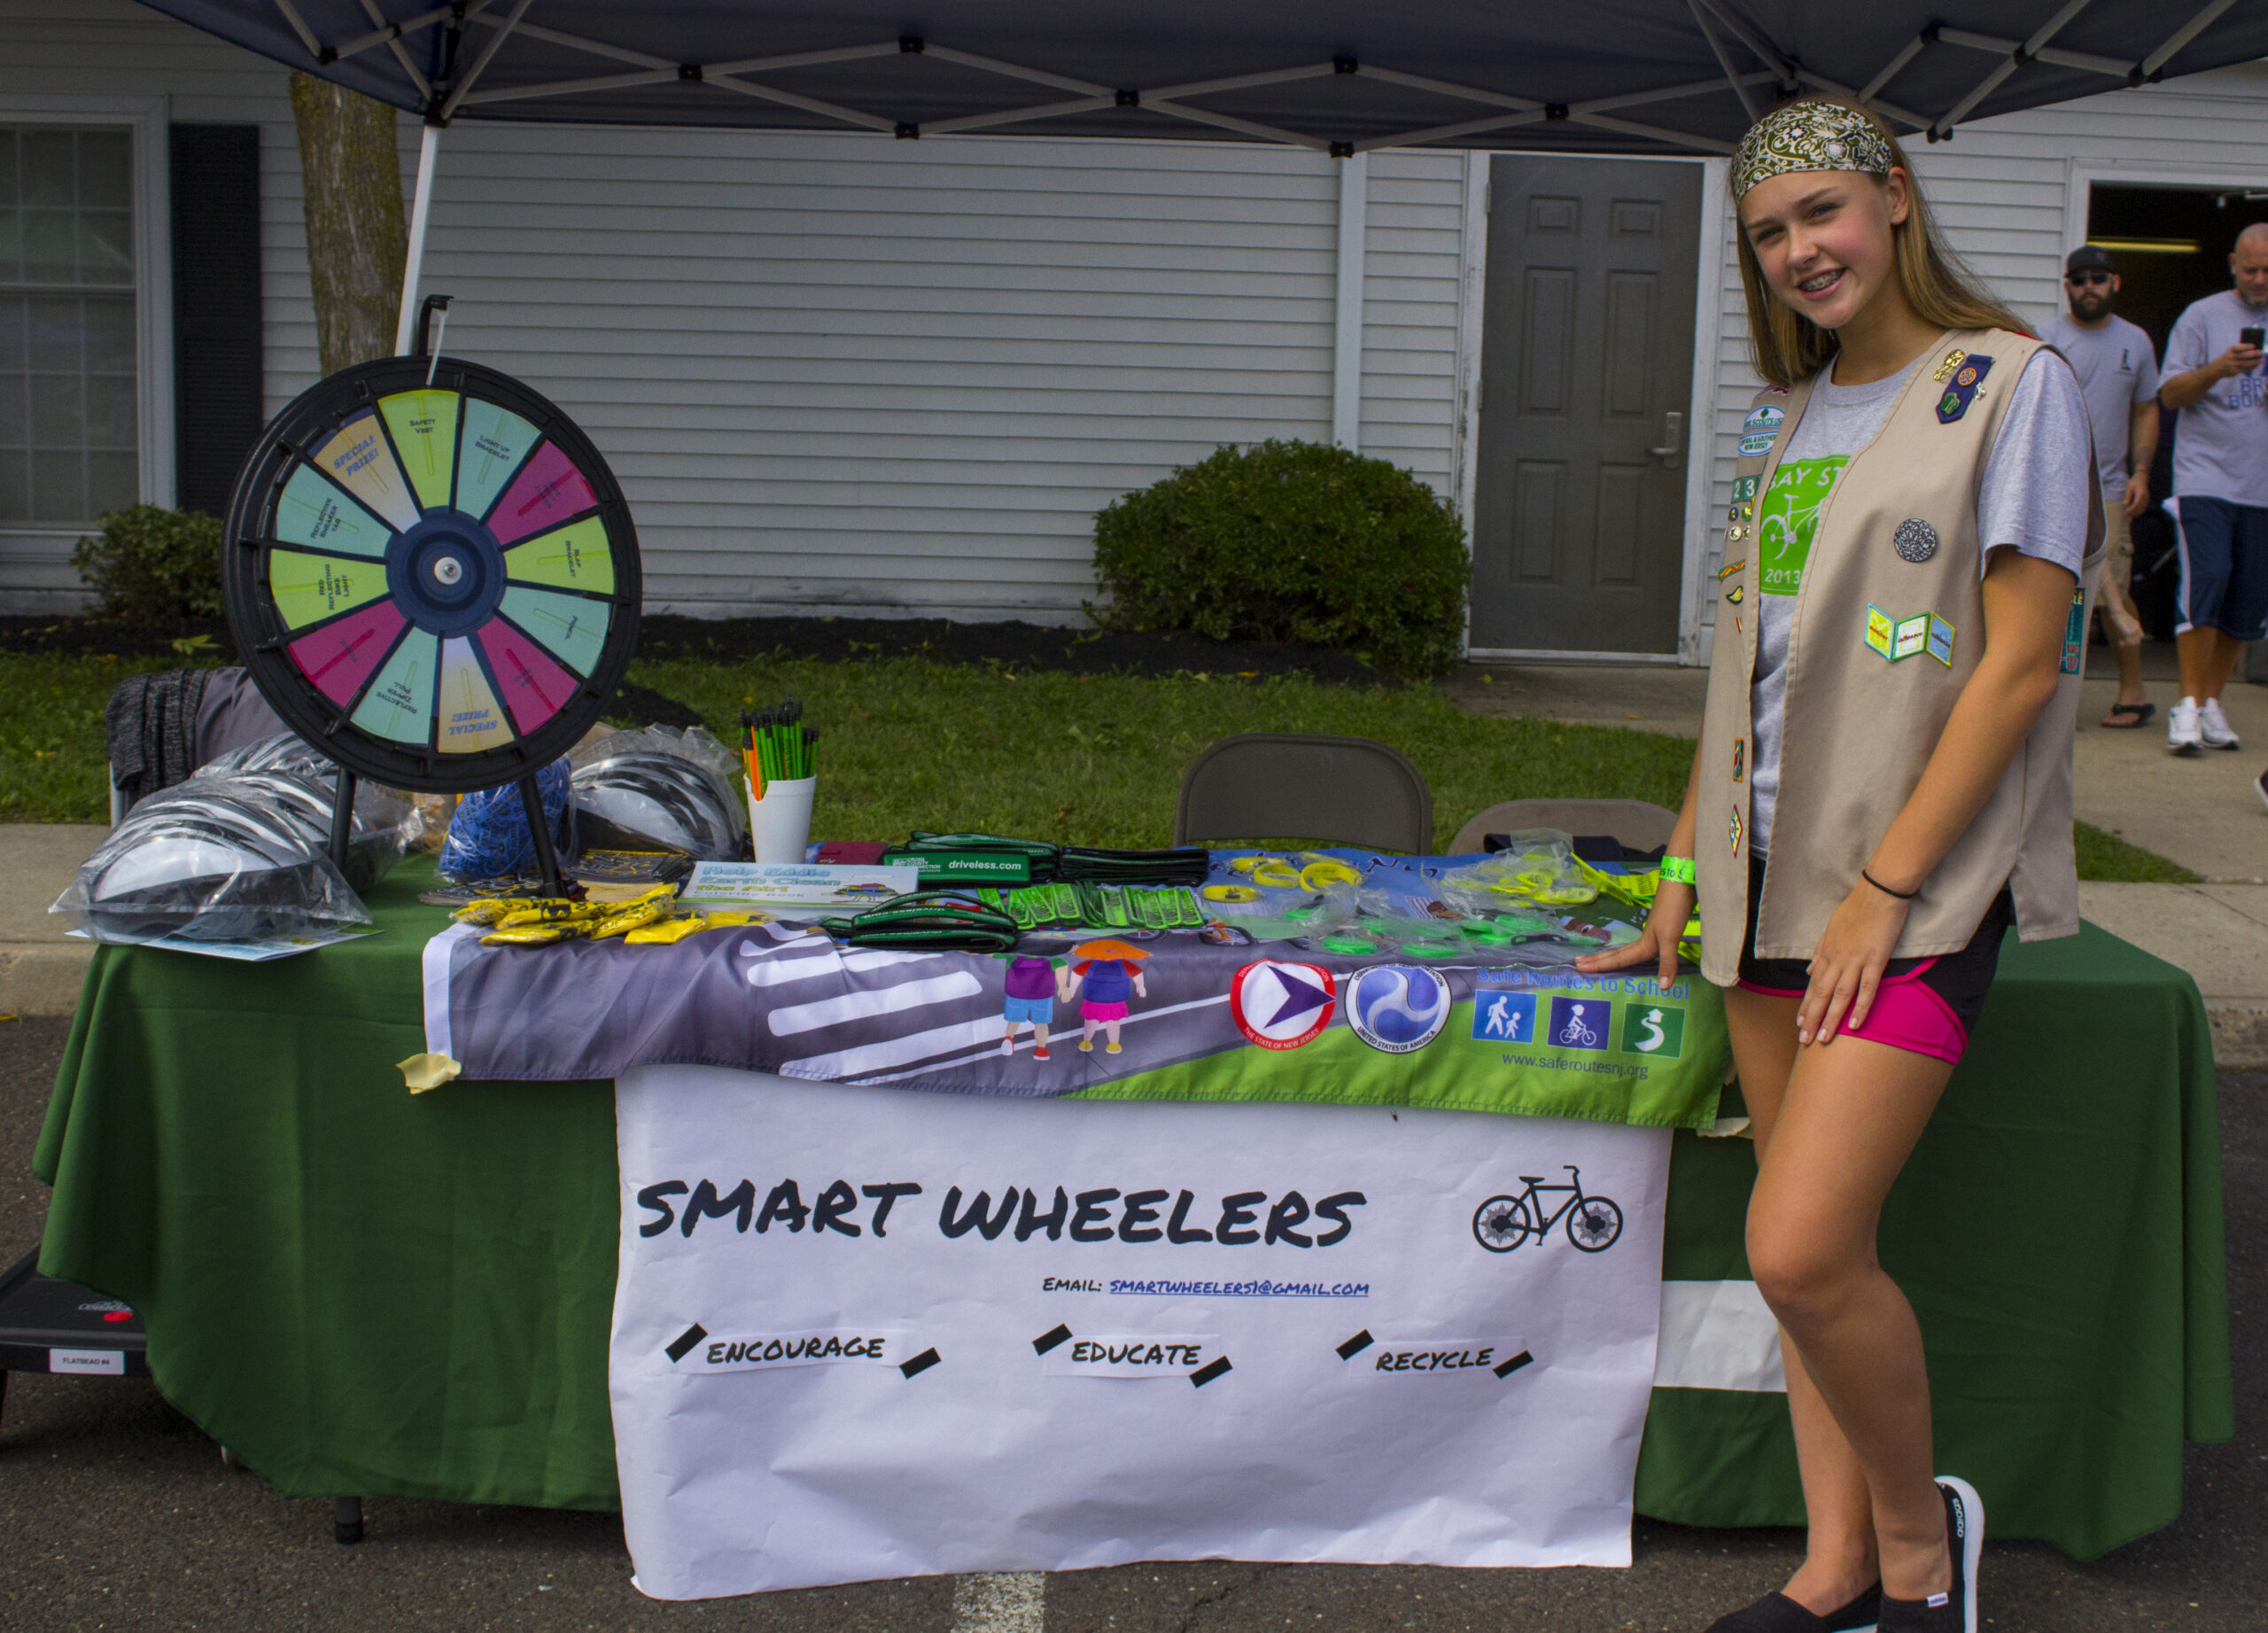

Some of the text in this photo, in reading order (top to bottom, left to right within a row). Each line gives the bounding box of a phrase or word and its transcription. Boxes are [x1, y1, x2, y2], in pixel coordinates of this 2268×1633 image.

[409, 418, 436, 427] SAFETY
[333, 434, 377, 470] SPECIAL
[346, 448, 379, 476] PRIZE!
[475, 441, 510, 462] BRACELET
[310, 497, 332, 539] REFLECTIVE
[331, 518, 341, 532] TAG
[1765, 569, 1801, 585] 2013
[375, 691, 417, 714] REFLECTIVE
[448, 720, 498, 735] SPECIAL
[451, 709, 489, 723] PRIZE!
[703, 866, 830, 877] Help Eddie
[949, 860, 1021, 870] driveless.com
[1476, 968, 1522, 984] Safe
[1527, 970, 1594, 991] Routes
[1599, 976, 1618, 992] to
[1244, 1027, 1254, 1040] THE
[1254, 1036, 1273, 1048] STATE
[1284, 1039, 1299, 1048] NEW
[1299, 1027, 1319, 1046] JERSEY
[1357, 1026, 1377, 1046] UNITED
[1376, 1041, 1399, 1052] STATES
[1409, 1030, 1436, 1050] AMERICA
[1502, 1054, 1649, 1079] www.saferoutesnj.org
[637, 1178, 1367, 1248] SMART WHEELERS
[1043, 1277, 1102, 1292] EMAIL:
[707, 1336, 886, 1364] ENCOURAGE
[1072, 1341, 1202, 1365] EDUCATE
[1375, 1347, 1495, 1372] RECYCLE
